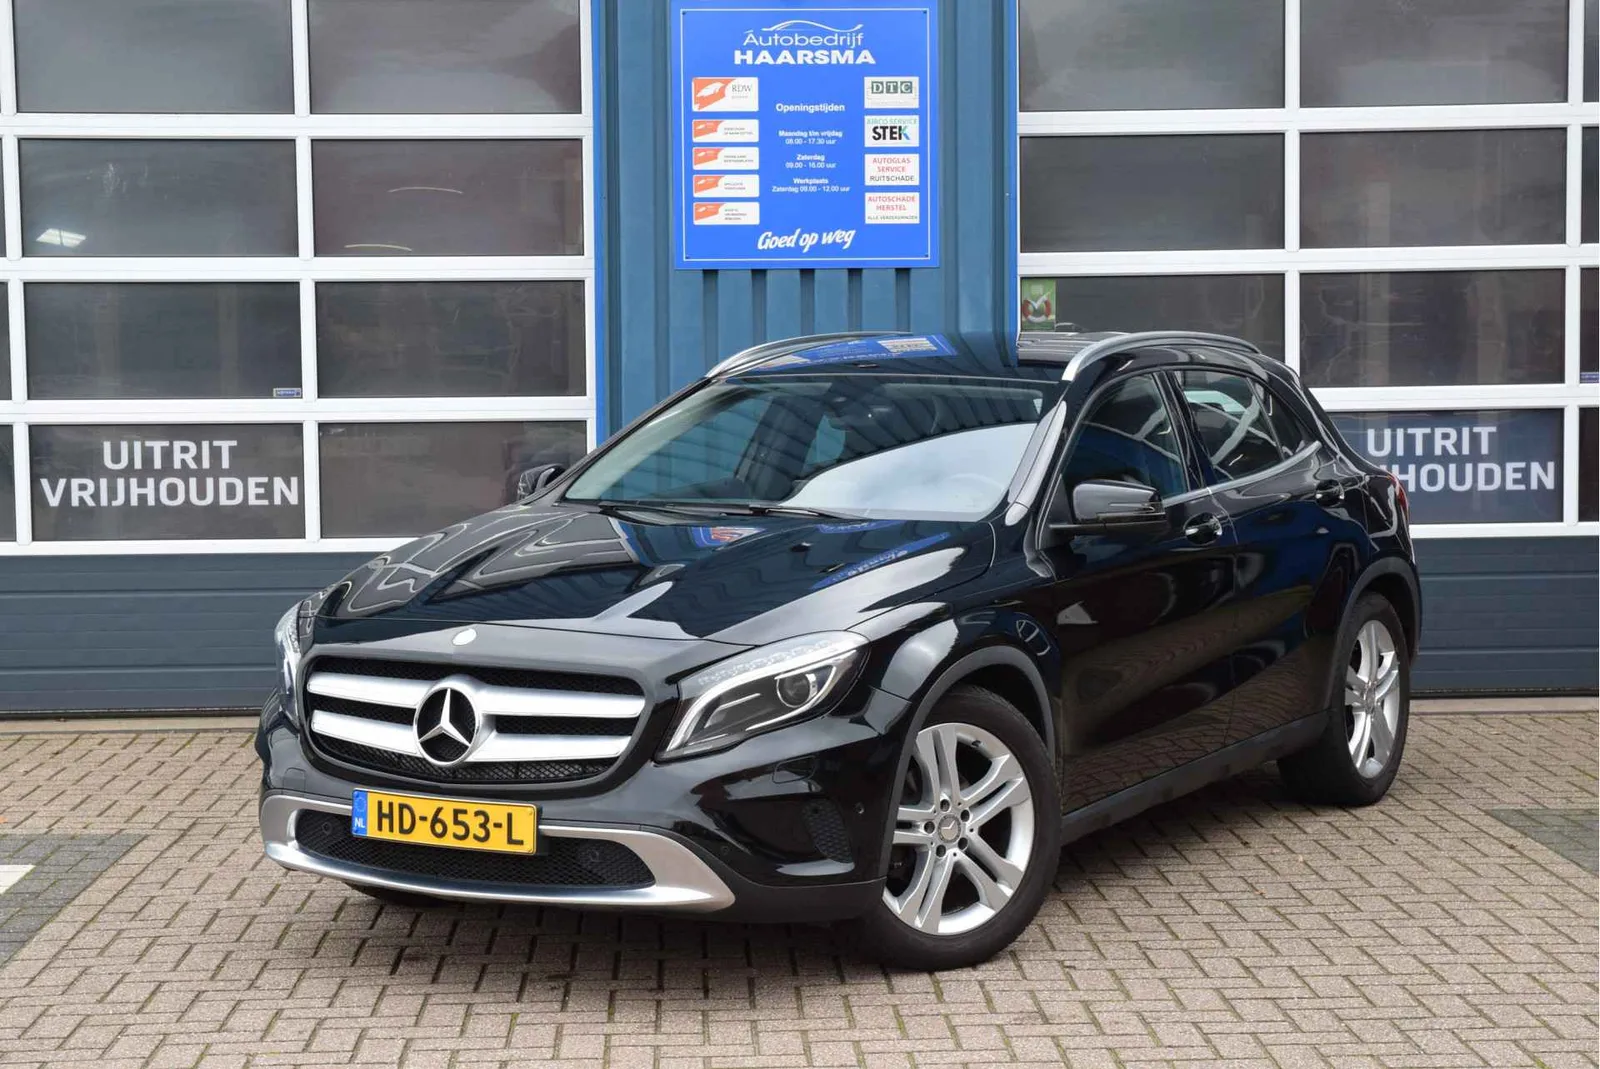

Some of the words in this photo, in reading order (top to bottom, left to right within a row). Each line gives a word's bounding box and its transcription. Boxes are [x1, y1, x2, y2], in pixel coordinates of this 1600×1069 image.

[734, 50, 876, 65] HAARSMA
[731, 84, 752, 92] RDW
[872, 81, 912, 94] DTC
[776, 103, 845, 113] Openingstijden
[820, 130, 843, 138] vrijdag
[872, 125, 910, 141] STEK
[796, 153, 825, 161] Zaterdag
[792, 177, 829, 185] Werkplaats
[757, 228, 801, 250] Goed
[799, 232, 819, 254] op
[821, 229, 856, 250] weg
[1367, 426, 1497, 457] UITRIT
[102, 440, 238, 470] UITRIT
[1380, 461, 1555, 492] HOUDEN
[39, 476, 299, 507] VRIJHOUDEN
[354, 816, 366, 829] NL
[377, 799, 524, 846] HD-653-L
